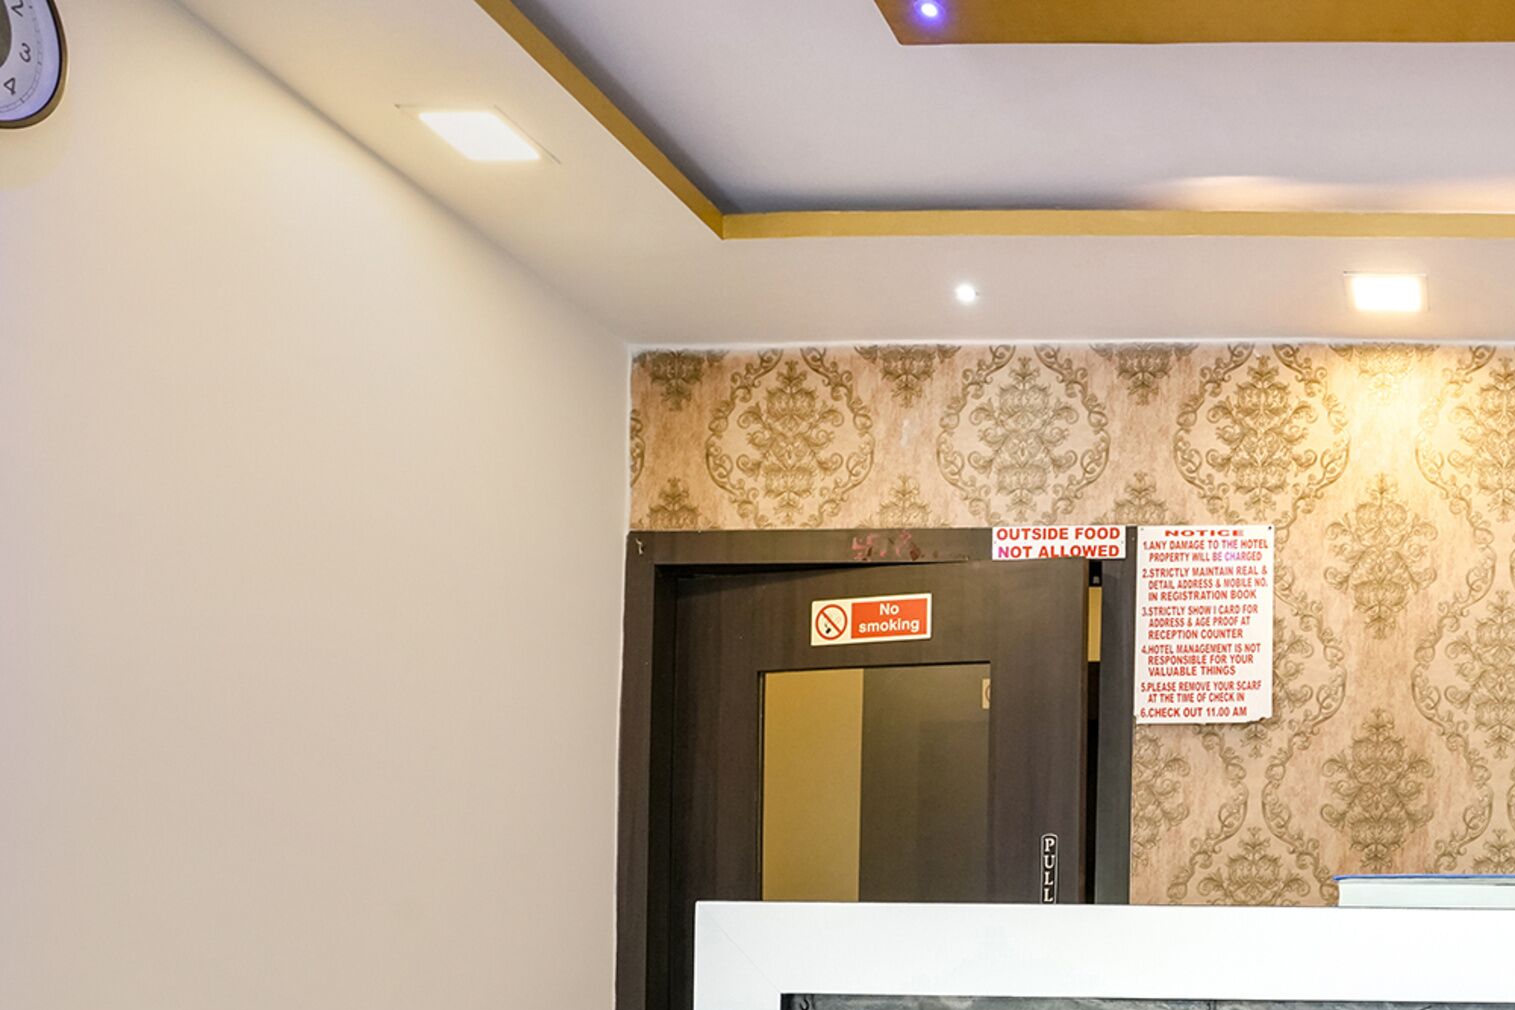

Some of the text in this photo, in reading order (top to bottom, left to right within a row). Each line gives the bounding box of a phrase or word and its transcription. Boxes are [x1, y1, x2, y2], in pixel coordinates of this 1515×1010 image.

[997, 527, 1120, 540] OUTSIDE FOOD
[1143, 539, 1268, 550] 1.ANY DAMAGE TO THE HOTEL
[998, 545, 1119, 558] NOT ALLOWED
[1149, 551, 1262, 562] PROPERTY WILL BE CHARGED
[1142, 565, 1267, 578] 2.STRICTLY MAINTAIN REAL &
[1149, 578, 1268, 590] DETAIL ADDRESS & MOBILE NO.
[1149, 590, 1257, 601] IN REGISTRATION BOOK
[880, 603, 900, 615] No
[1142, 606, 1185, 616] 3.STRICTLY
[1188, 606, 1211, 615] SHOW
[1218, 605, 1240, 614] CARD
[1243, 604, 1258, 613] FOR
[858, 618, 920, 633] smoking
[1149, 616, 1250, 628] ADDRESS & AGE PROOF AT
[1148, 629, 1243, 640] RECEPTION COUNTER
[1141, 643, 1261, 654] 4.HOTEL MANAGEMENT IS NOT
[1148, 654, 1254, 665] RESPONSIBLE FOR YOUR
[1149, 665, 1236, 676] VALUABLE THINGS
[1141, 680, 1261, 692] 5.PLEASE REMOVE YOUR SCARF
[1148, 692, 1244, 703] AT THE TIME OF CHECK IN
[1140, 706, 1247, 718] 6.CHECK OUT 11.00 AM
[1044, 838, 1055, 901] PULL
